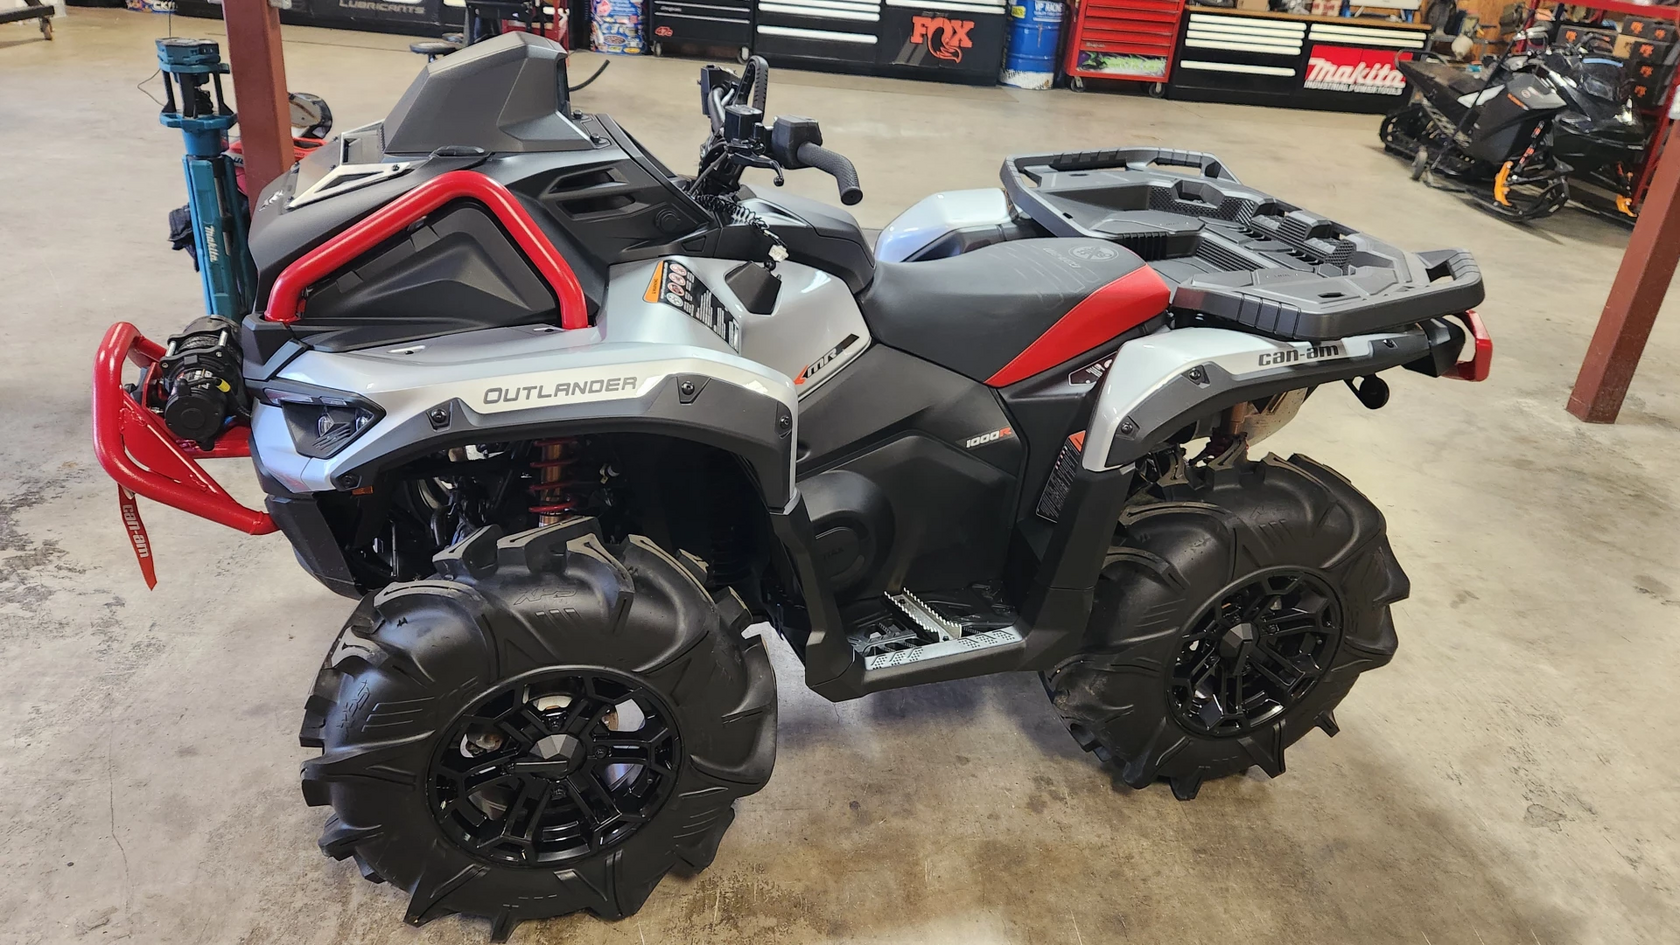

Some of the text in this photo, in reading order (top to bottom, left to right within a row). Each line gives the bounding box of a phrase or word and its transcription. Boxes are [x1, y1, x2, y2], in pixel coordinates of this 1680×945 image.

[339, 0, 425, 14] LUBRICANTS
[911, 16, 975, 63] FOX
[1308, 57, 1406, 88] Makita
[204, 225, 219, 262] Makita
[1258, 345, 1339, 366] can-am
[483, 376, 637, 405] OUTLANDER
[966, 427, 1012, 448] 1000R
[122, 504, 150, 558] can-am
